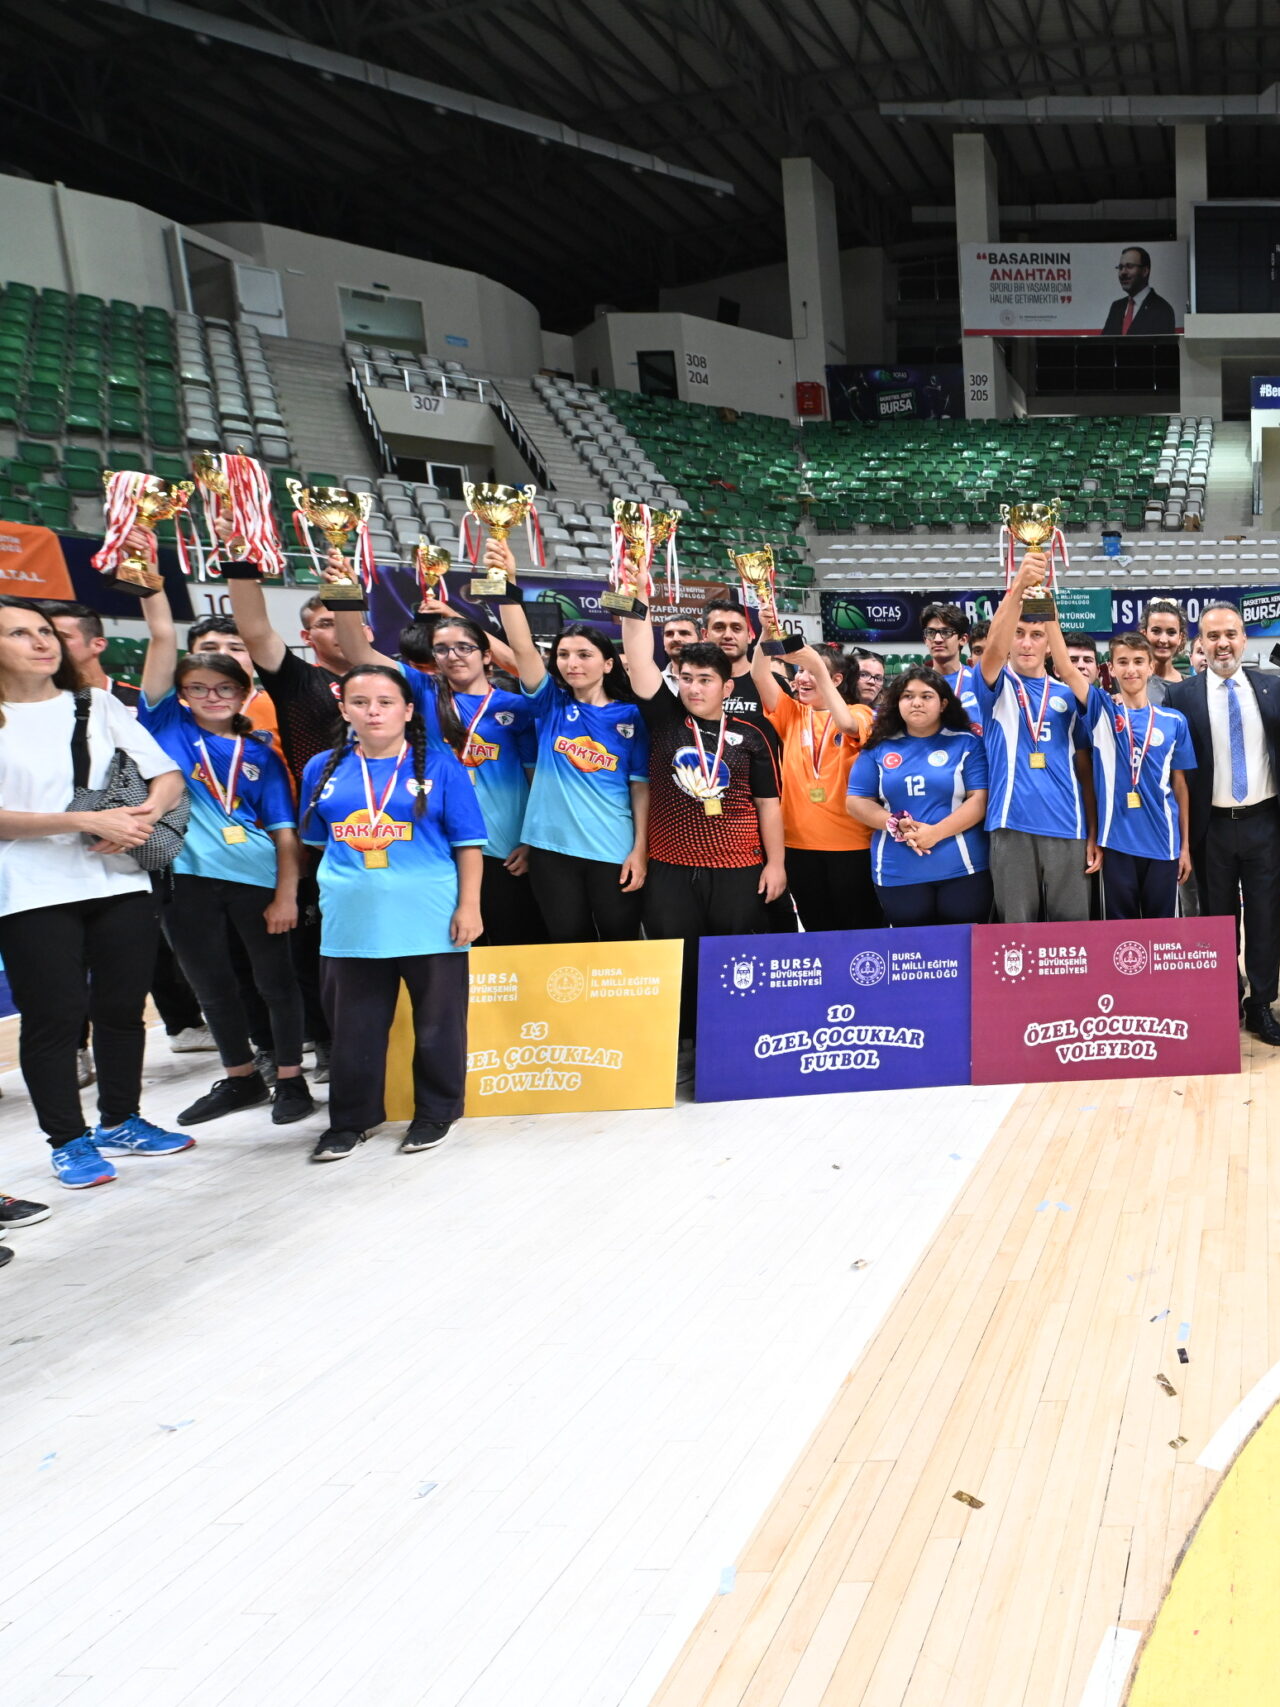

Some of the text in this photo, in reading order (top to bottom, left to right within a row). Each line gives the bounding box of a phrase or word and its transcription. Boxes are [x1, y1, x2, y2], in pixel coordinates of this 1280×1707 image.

[990, 268, 1071, 280] ANAHTARI
[686, 353, 707, 369] 308
[688, 369, 709, 385] 204
[970, 375, 988, 386] 309
[971, 390, 988, 401] 205
[413, 396, 440, 412] 307
[880, 399, 913, 414] BURSA
[1243, 597, 1271, 607] BASKETBOL
[651, 604, 704, 615] ZAFER KOYU
[867, 606, 901, 621] TOFAŞ
[1066, 611, 1096, 620] TÜRKÜN
[557, 738, 616, 768] BAKTAT
[904, 775, 926, 797] 12
[334, 823, 408, 841] BAKTAT
[1038, 946, 1087, 958] BURSA
[1153, 942, 1182, 951] BURSA
[892, 952, 921, 961] BURSA
[1154, 950, 1217, 961] İL MİLLİ EĞİTİM
[770, 958, 822, 970] BURSA
[892, 959, 958, 971] İL MİLLİ EĞİTİM
[1038, 957, 1087, 967] BÜYÜKŞEHİR
[1154, 959, 1217, 971] MÜDÜRLÜĞÜ
[591, 968, 622, 977] BURSA
[770, 968, 822, 979] BÜYÜKŞEHİR
[892, 968, 958, 981] MÜDÜRLÜĞÜ
[1038, 964, 1088, 975] BELEDİYESİ
[591, 977, 660, 987] İL MİLLİ EĞİTİM
[770, 977, 822, 988] BELEDİYESİ
[469, 984, 518, 993] ÜYÜKŞEHİR
[590, 986, 660, 997] MÜDÜRLÜĞÜ
[469, 992, 518, 1003] ELEDİYESİ
[1097, 993, 1114, 1013] 9
[827, 1004, 855, 1022] 10
[521, 1021, 549, 1041] 13
[1024, 1015, 1188, 1047] ÖZEL ÇOCUKLAR
[754, 1027, 924, 1058] ÖZEL ÇOCUKLAR
[467, 1045, 623, 1072] ZEL ÇOCUKLAR
[1056, 1041, 1157, 1064] VOLEYBOL
[800, 1050, 880, 1074] FUTBOL
[479, 1066, 582, 1096] BOWLİNG
